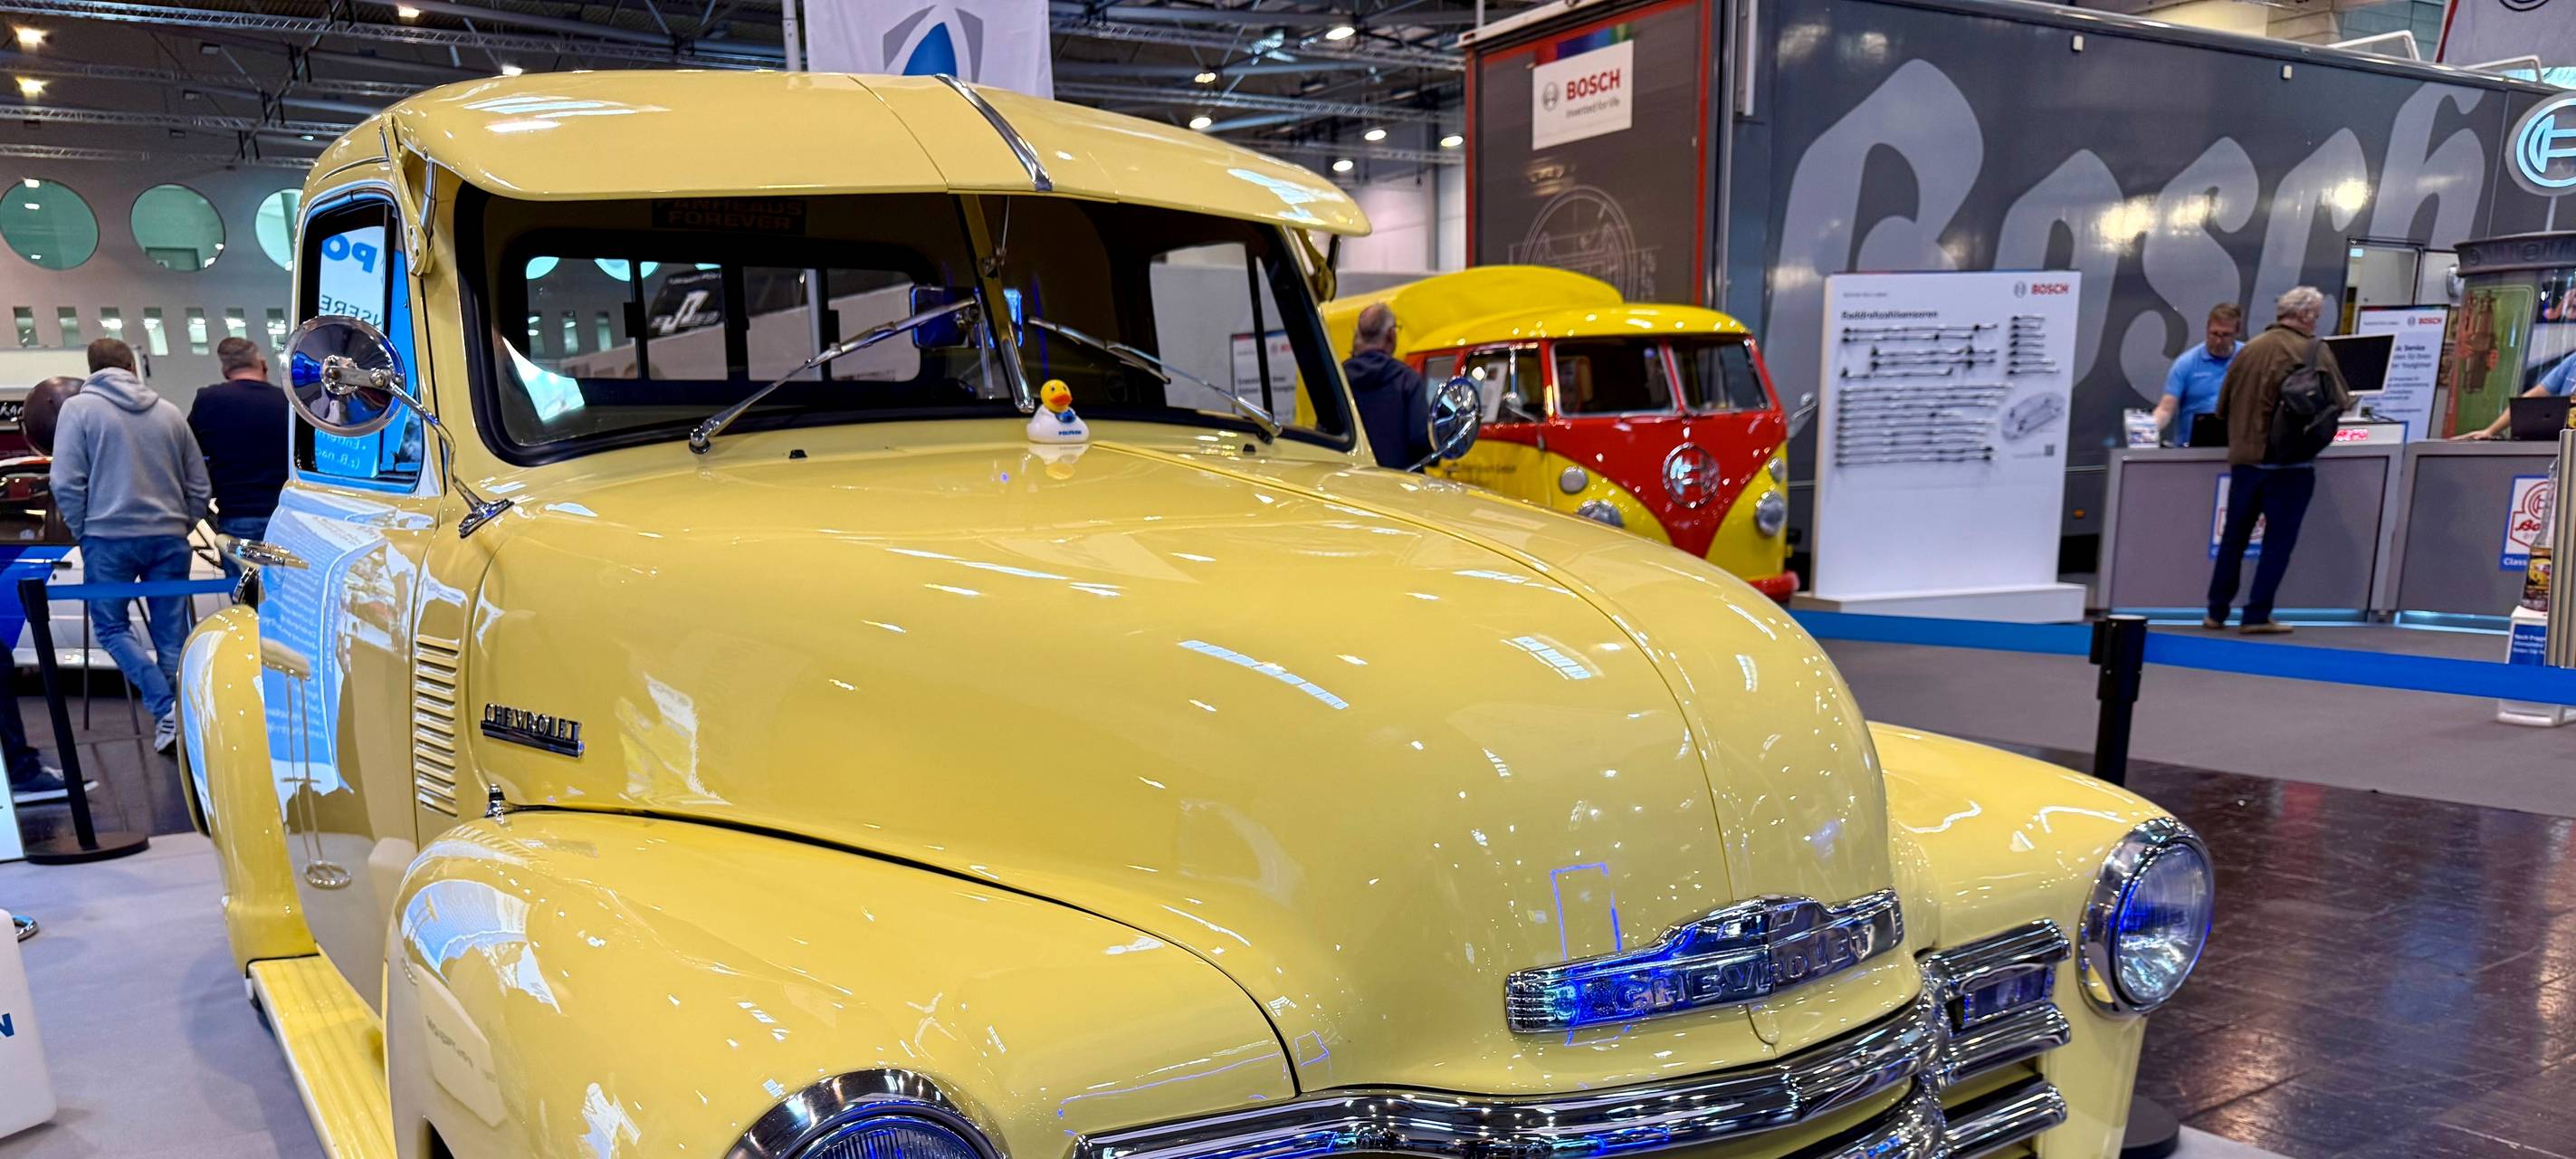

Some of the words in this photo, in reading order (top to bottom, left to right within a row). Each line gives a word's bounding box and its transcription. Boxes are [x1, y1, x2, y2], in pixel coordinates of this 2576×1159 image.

[1567, 69, 1620, 101] BOSCH
[669, 211, 792, 229] FOREVER
[2031, 283, 2069, 295] BOSCH
[2418, 317, 2443, 326] BOSCH
[2503, 557, 2528, 566] Class
[484, 703, 580, 742] CHEVROLET
[1615, 924, 1875, 1011] CHEVROLET
